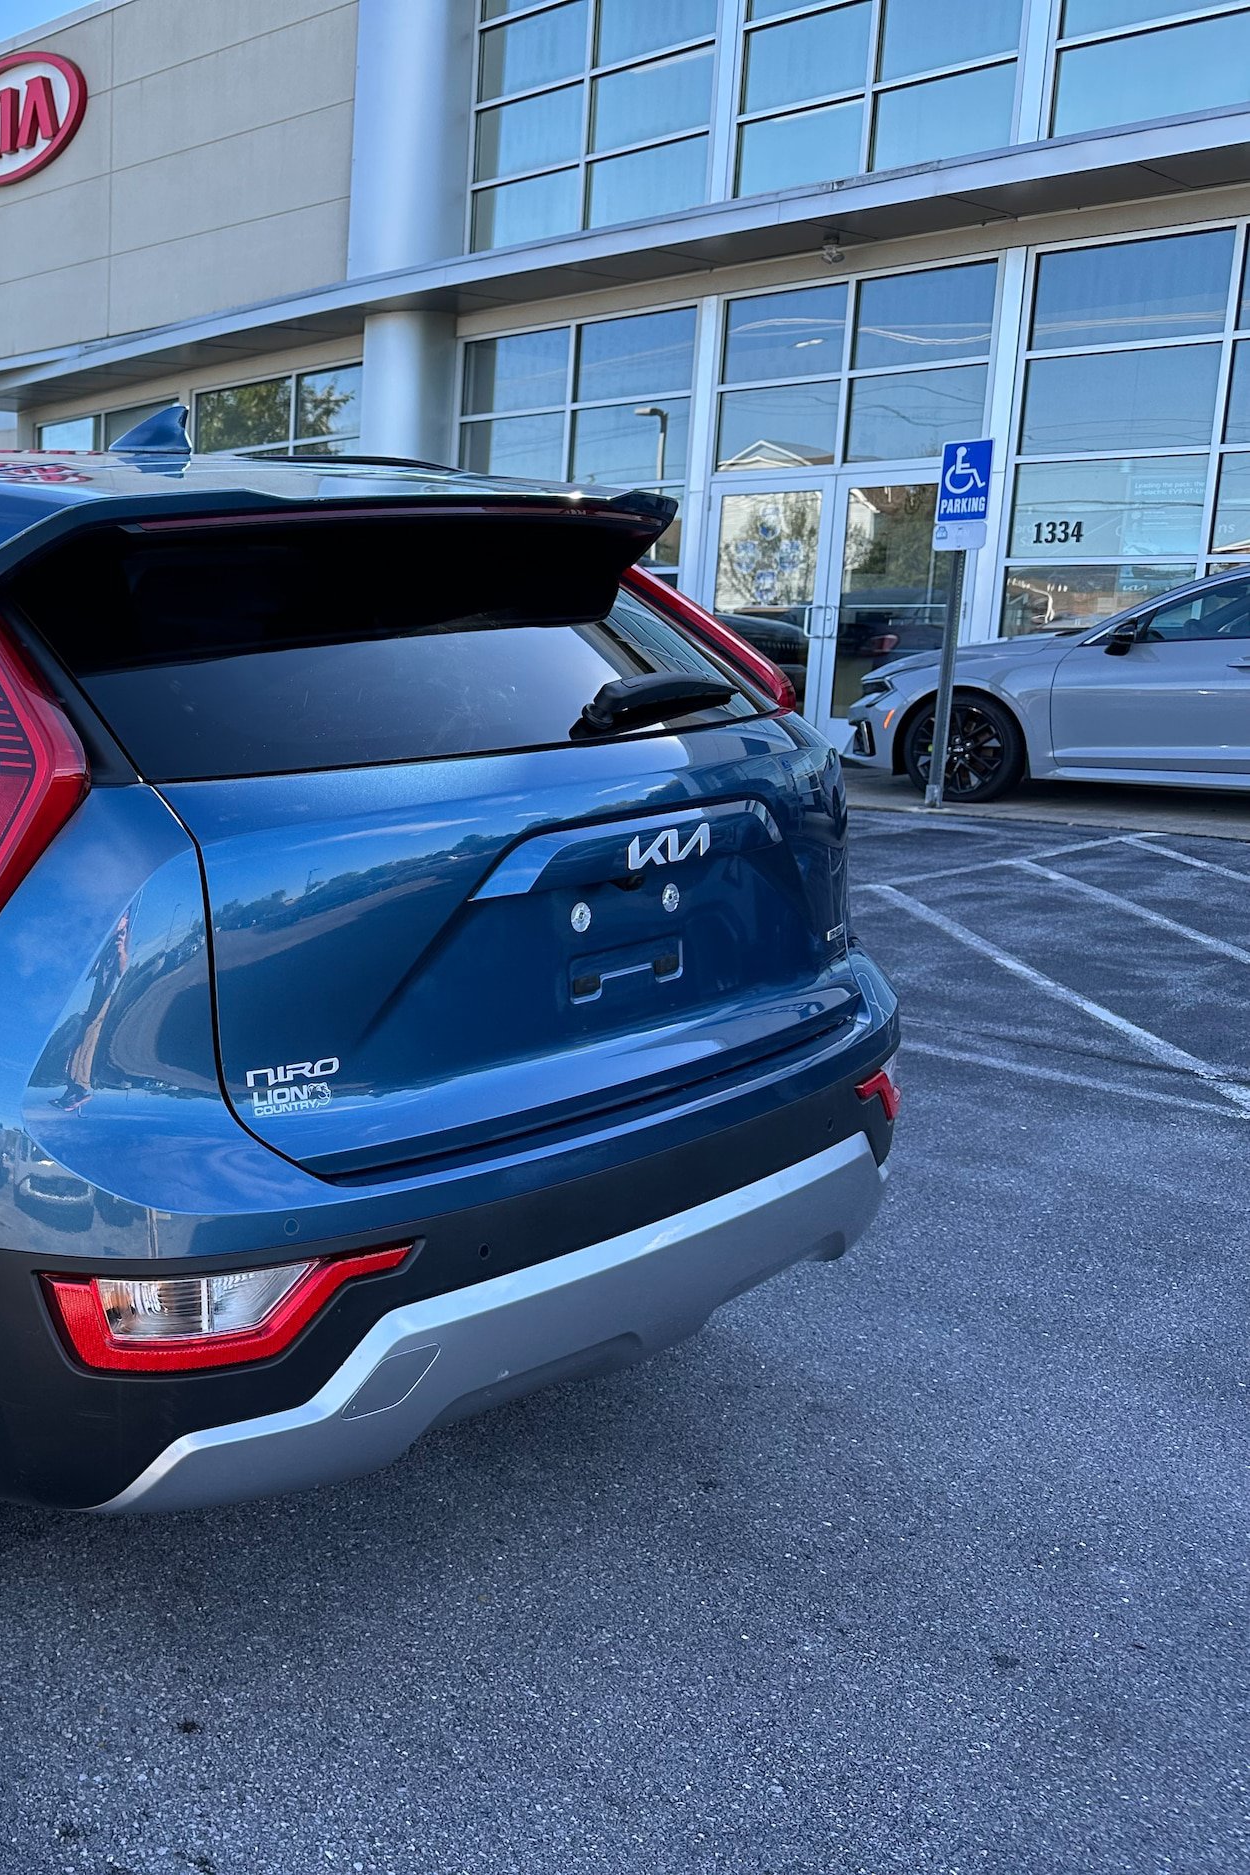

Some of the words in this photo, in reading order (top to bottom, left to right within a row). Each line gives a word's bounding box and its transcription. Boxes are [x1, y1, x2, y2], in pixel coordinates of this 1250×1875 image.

[940, 496, 986, 515] PARKING
[1032, 520, 1084, 544] 1334
[628, 822, 711, 871] KIA
[246, 1057, 340, 1088] NIRO
[253, 1085, 309, 1107] LION
[254, 1099, 318, 1117] COUNTRY
